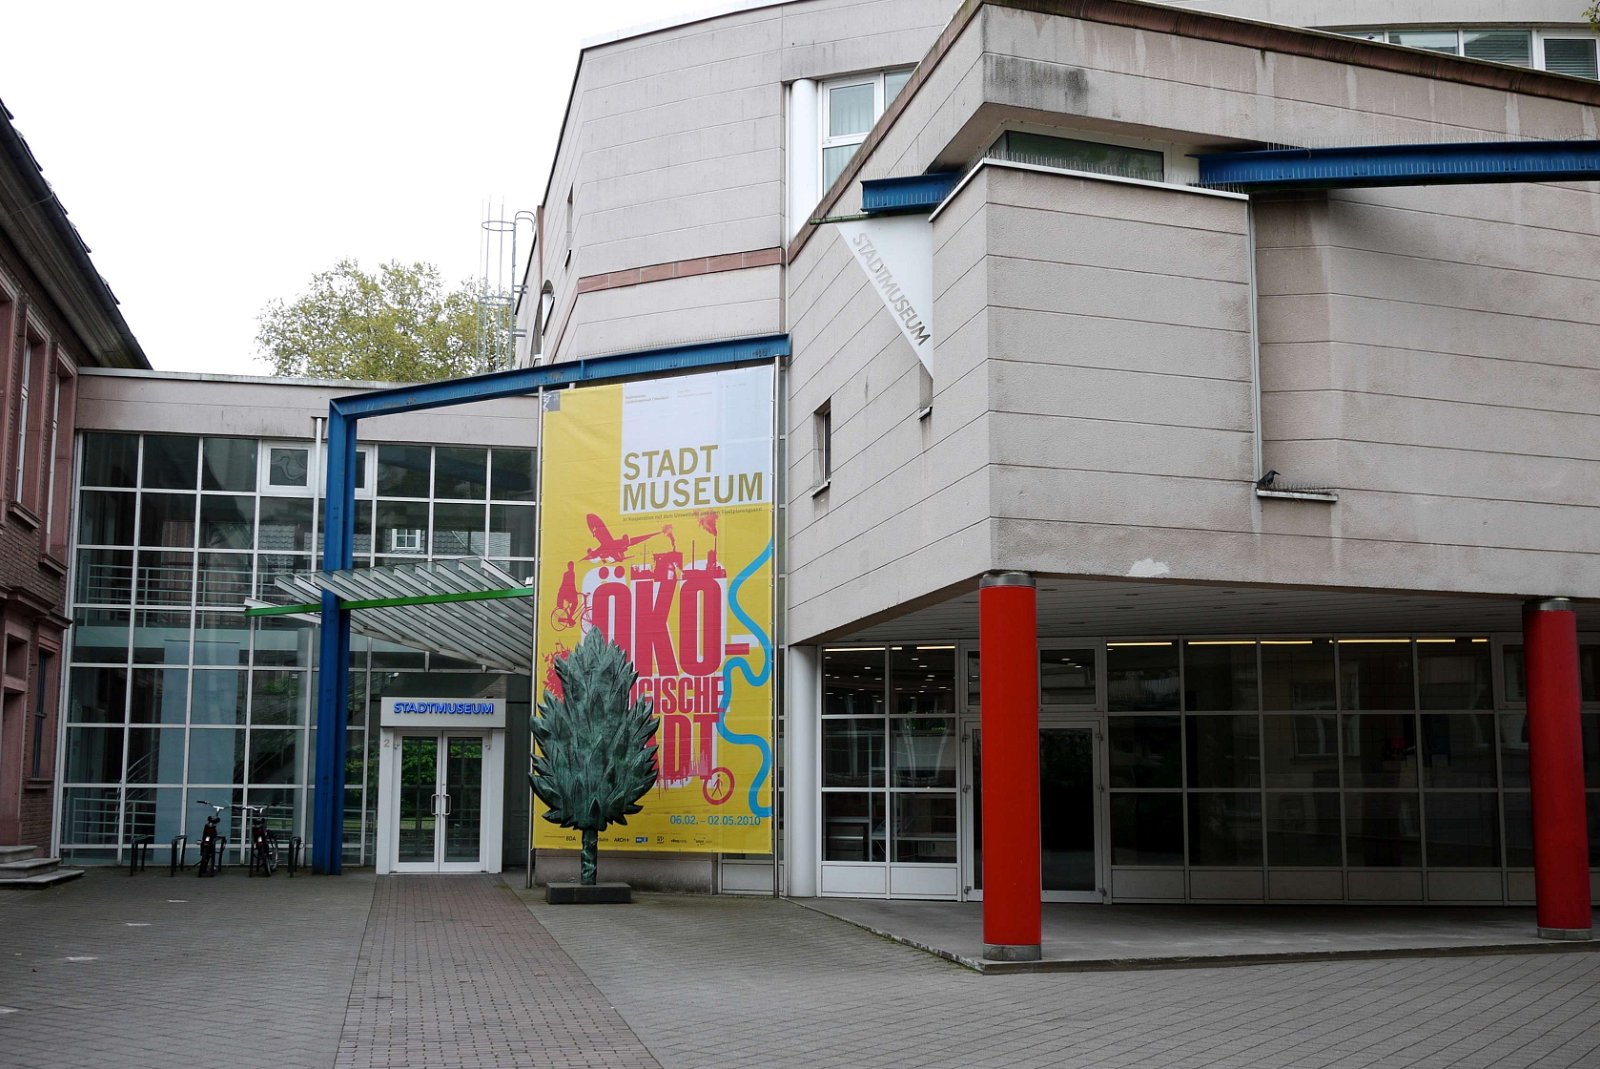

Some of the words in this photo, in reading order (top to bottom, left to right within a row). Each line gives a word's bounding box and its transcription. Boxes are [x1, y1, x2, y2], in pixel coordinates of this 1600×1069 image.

[852, 232, 931, 346] STADTMUSEUM
[623, 444, 719, 481] STADT
[623, 471, 763, 512] MUSEUM
[394, 702, 494, 715] STADTMUSEUM
[383, 739, 390, 748] 2
[670, 816, 699, 826] 06.02.
[707, 815, 761, 826] 02.05.2010
